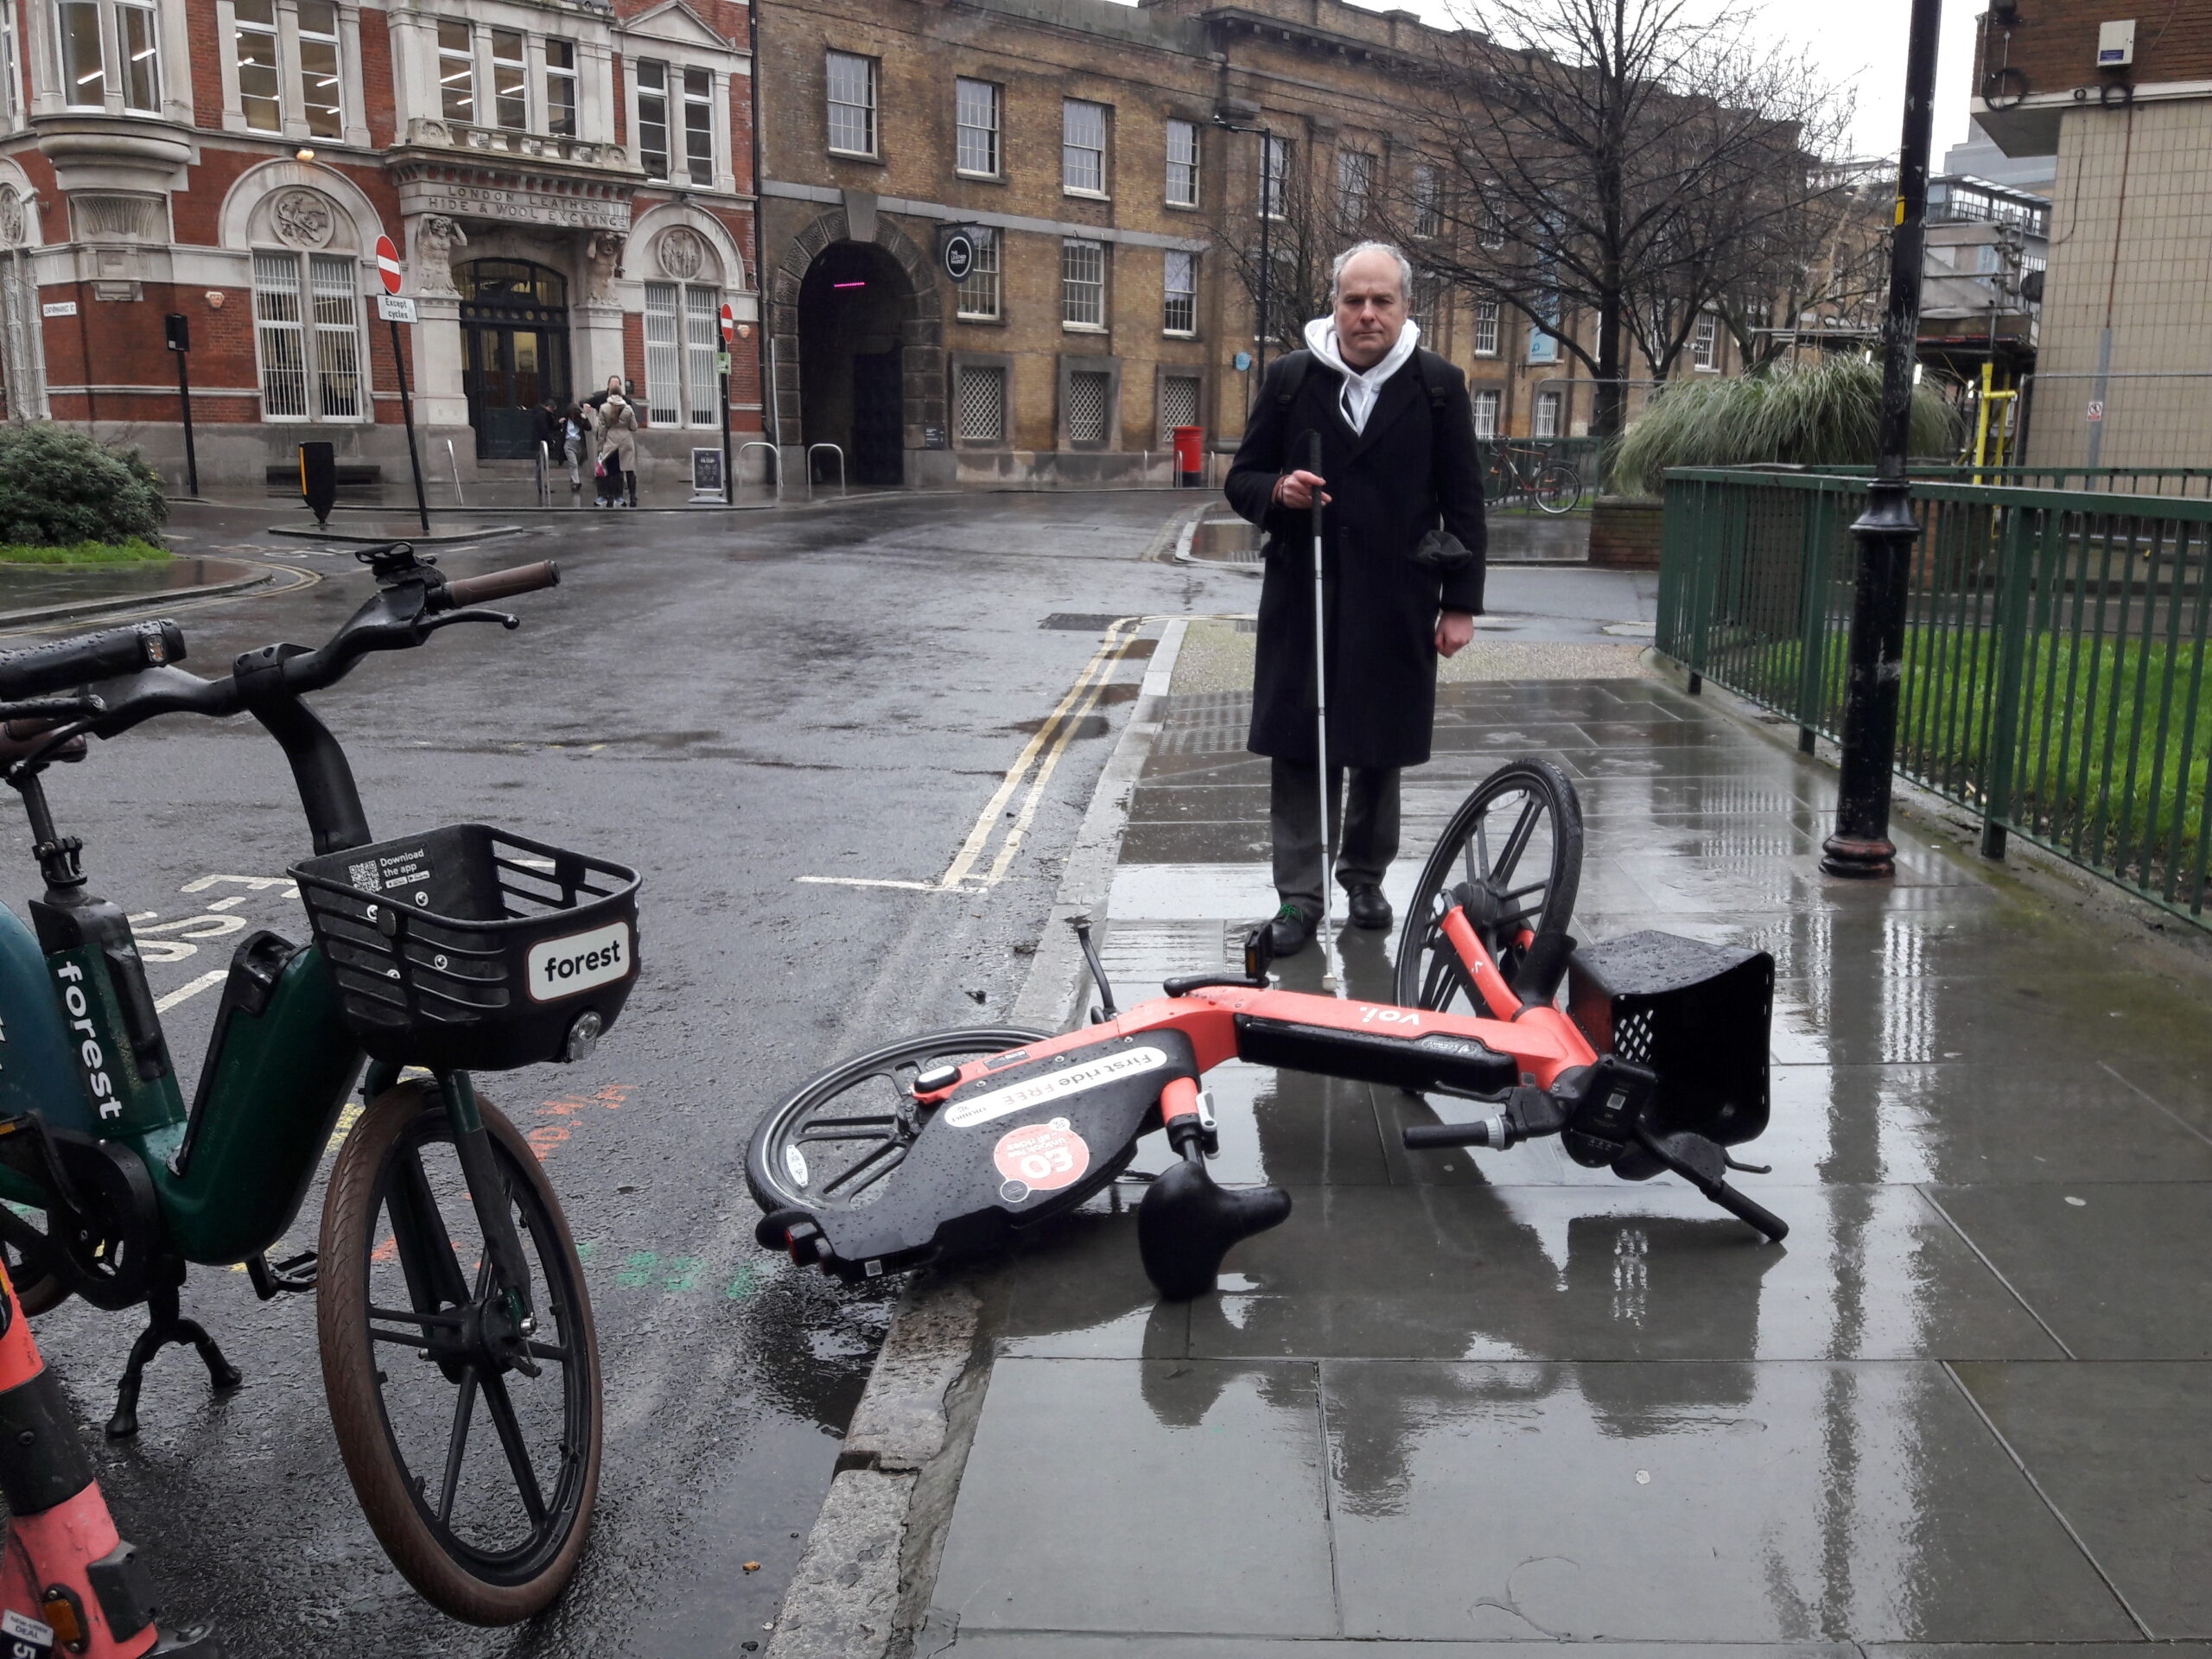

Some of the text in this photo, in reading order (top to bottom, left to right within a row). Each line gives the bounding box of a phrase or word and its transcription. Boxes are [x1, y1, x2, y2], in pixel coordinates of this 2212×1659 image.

[448, 186, 514, 202] LONDON
[429, 197, 468, 212] HIDE
[479, 201, 488, 213] &
[496, 204, 537, 219] WOOL
[385, 297, 408, 309] Except
[388, 310, 409, 319] cycles
[380, 848, 425, 867] Download
[383, 867, 399, 878] the
[400, 863, 417, 874] app
[544, 939, 621, 982] forest
[57, 960, 124, 1121] forest
[1001, 1053, 1154, 1105] First ride FREE
[1027, 1137, 1067, 1153] unlock
[1020, 1146, 1074, 1179] £0
[16, 1625, 39, 1639] DEAL
